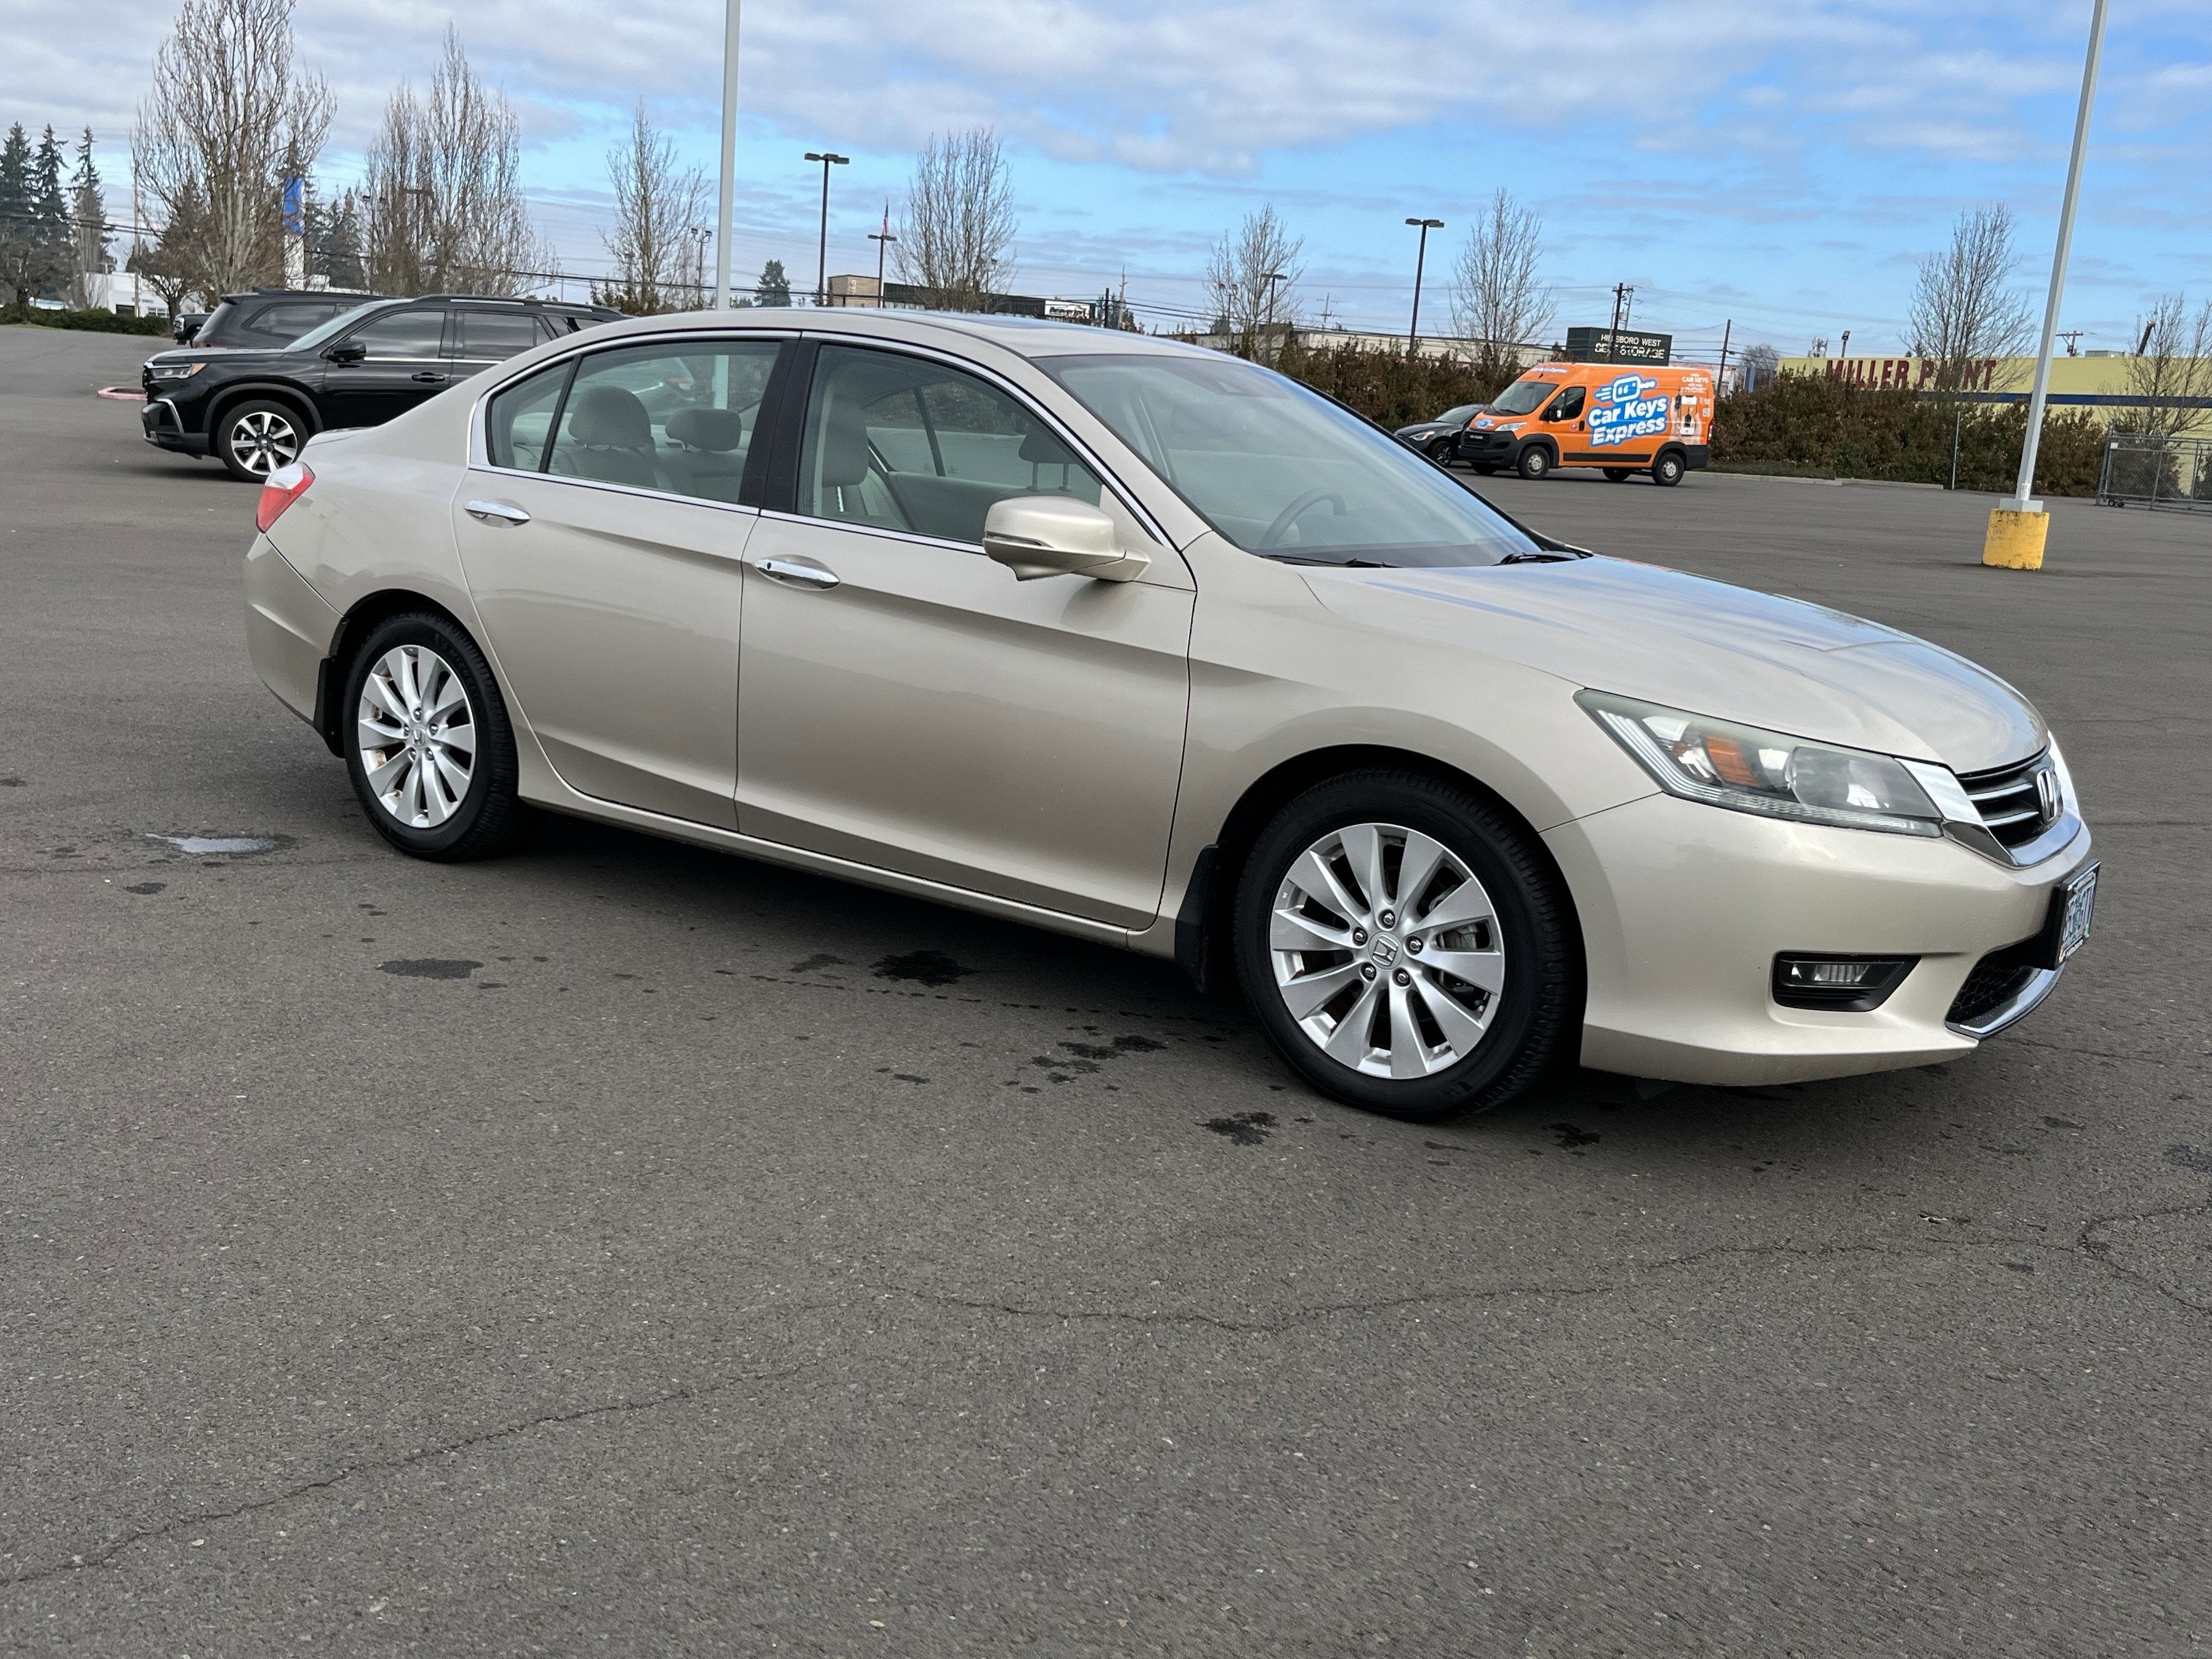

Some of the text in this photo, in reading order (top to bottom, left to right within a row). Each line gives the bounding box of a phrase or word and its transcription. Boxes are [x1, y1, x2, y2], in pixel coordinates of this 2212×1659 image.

[1642, 338, 1662, 347] WEST
[1588, 398, 1667, 427] Car Keys
[1592, 417, 1665, 445] Express
